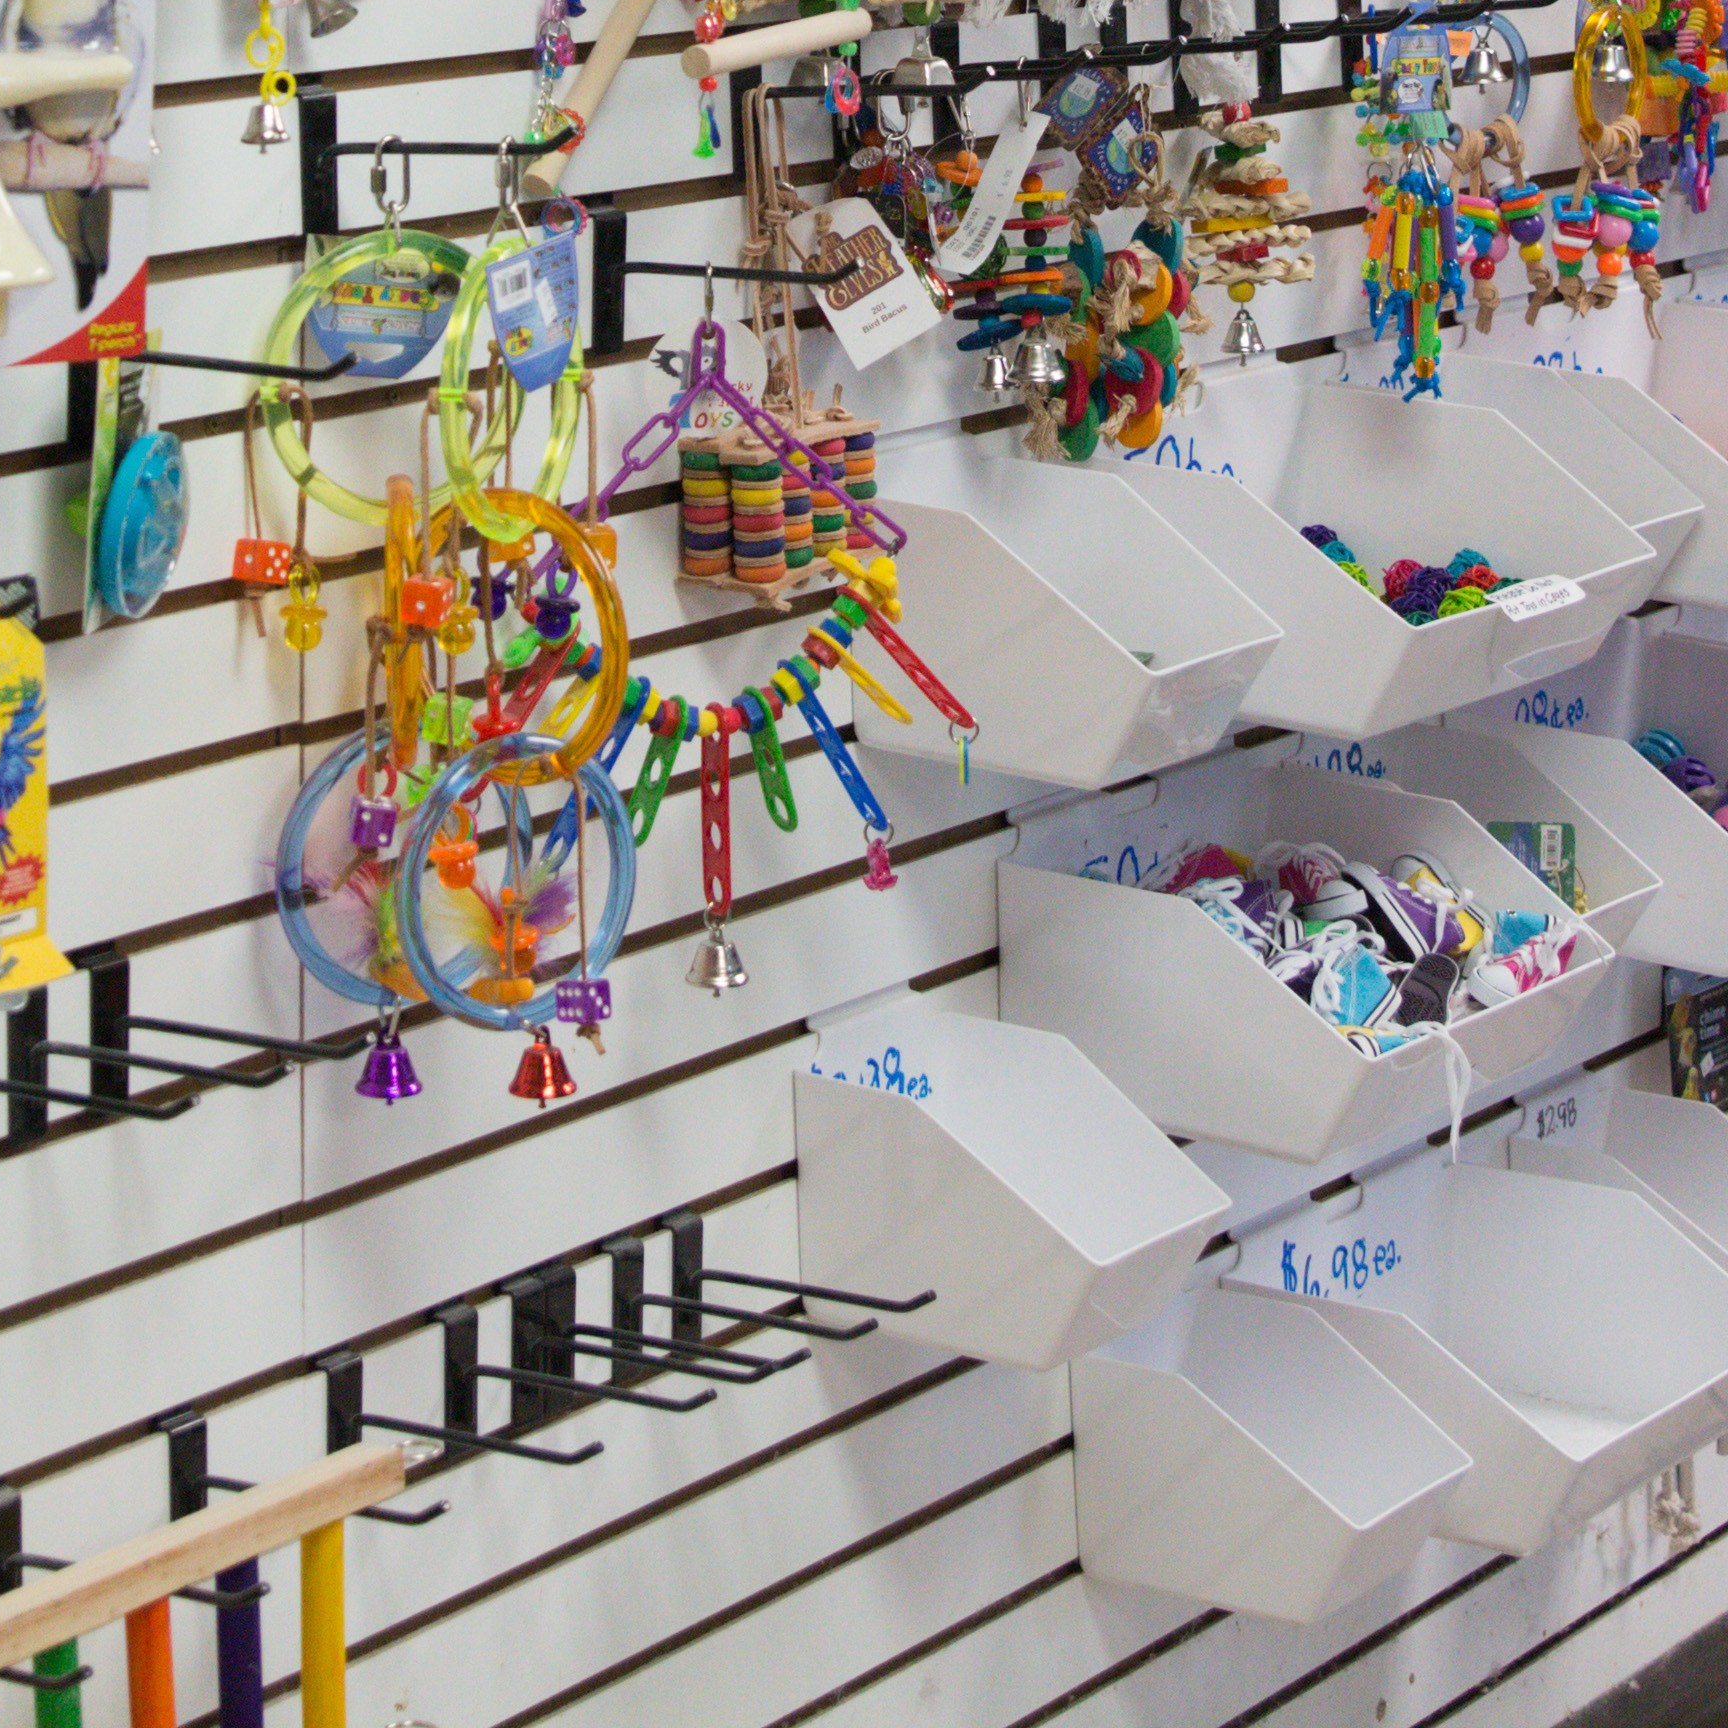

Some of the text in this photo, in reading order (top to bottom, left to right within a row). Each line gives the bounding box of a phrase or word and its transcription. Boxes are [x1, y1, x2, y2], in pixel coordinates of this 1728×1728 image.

[862, 303, 909, 334] Bird Bacus
[871, 302, 887, 316] 201
[87, 320, 137, 339] Regular
[1697, 1007, 1727, 1026] chime
[1698, 1023, 1724, 1038] time
